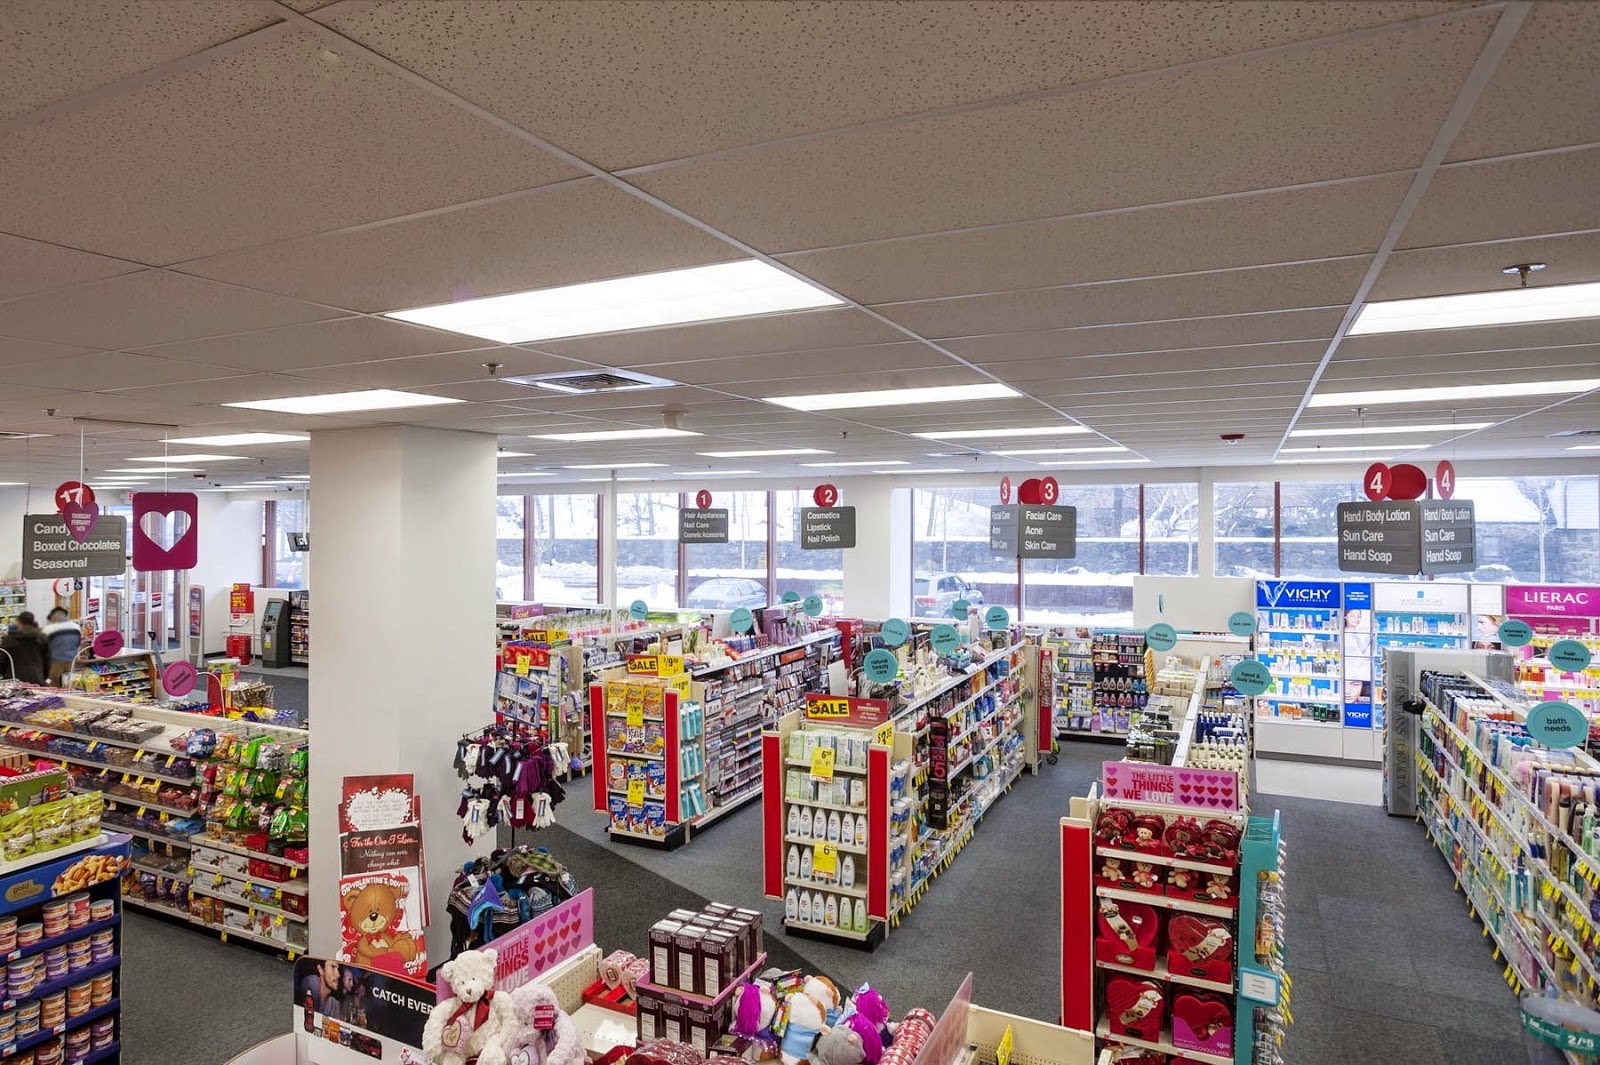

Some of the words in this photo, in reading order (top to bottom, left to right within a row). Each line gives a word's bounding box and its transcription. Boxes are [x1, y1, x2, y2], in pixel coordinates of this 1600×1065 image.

[1370, 471, 1383, 494] 4
[1441, 469, 1451, 492] 4
[60, 487, 83, 503] 17
[824, 489, 833, 503] 2
[1002, 483, 1008, 500] 3
[1044, 482, 1054, 500] 3
[700, 494, 707, 505] 1
[697, 512, 726, 521] Appliances
[807, 511, 841, 520] Cosmetics
[1025, 510, 1046, 521] Facial
[1046, 511, 1062, 521] Care
[1343, 510, 1361, 522] Hand
[1366, 509, 1385, 524] Body
[1385, 508, 1411, 521] Lotion
[1455, 508, 1471, 520] Lotion
[34, 522, 72, 537] Candy
[806, 523, 832, 532] Lipstick
[1025, 525, 1044, 535] Acne
[807, 535, 820, 543] Nail
[820, 535, 841, 543] Polish
[1342, 529, 1361, 542] Sun
[1361, 529, 1384, 542] Care
[1424, 529, 1439, 542] Sun
[1439, 529, 1455, 541] Care
[33, 540, 67, 553] Boxed
[68, 540, 121, 552] Chocolates
[1024, 540, 1040, 550] Skin
[1040, 541, 1057, 550] Care
[1343, 549, 1367, 561] Hand
[1367, 549, 1393, 565] Soap
[1426, 550, 1444, 563] Hand
[1444, 549, 1462, 563] Soap
[32, 557, 88, 570] Seasonal
[63, 582, 69, 592] 1
[1284, 588, 1332, 599] VICHY
[1524, 591, 1589, 605] LIERAC
[521, 631, 546, 642] SALE
[629, 658, 657, 671] SALE
[808, 699, 848, 715] SALE
[1546, 717, 1567, 725] bath
[1544, 724, 1572, 732] needs
[1131, 771, 1146, 780] THE
[1148, 773, 1174, 783] LITTLE
[1131, 779, 1174, 793] THINGS
[1123, 788, 1142, 800] WE
[1144, 790, 1174, 804] LOVE
[359, 848, 385, 859] Nothing
[367, 860, 386, 869] change
[386, 858, 400, 866] what
[351, 877, 388, 890] VALENTINE'S
[503, 937, 529, 961] LITTLE
[372, 986, 405, 1007] CATCH
[1258, 1032, 1272, 1065] CENT
